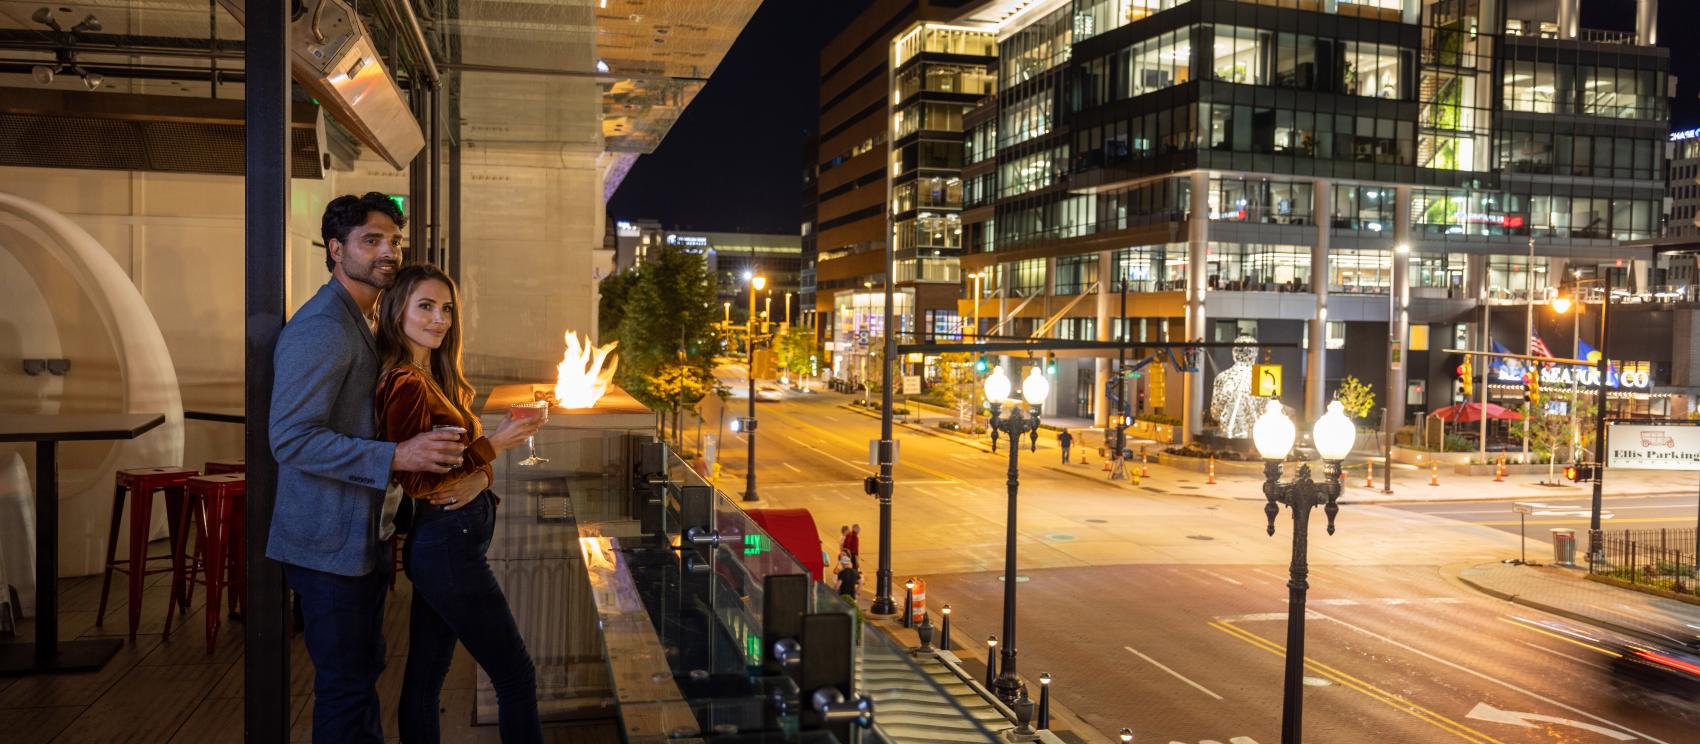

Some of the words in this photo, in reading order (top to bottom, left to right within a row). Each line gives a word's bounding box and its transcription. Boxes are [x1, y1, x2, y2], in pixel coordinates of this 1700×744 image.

[1620, 371, 1649, 388] CO
[1614, 450, 1643, 458] Ellis
[1647, 451, 1700, 462] Parking
